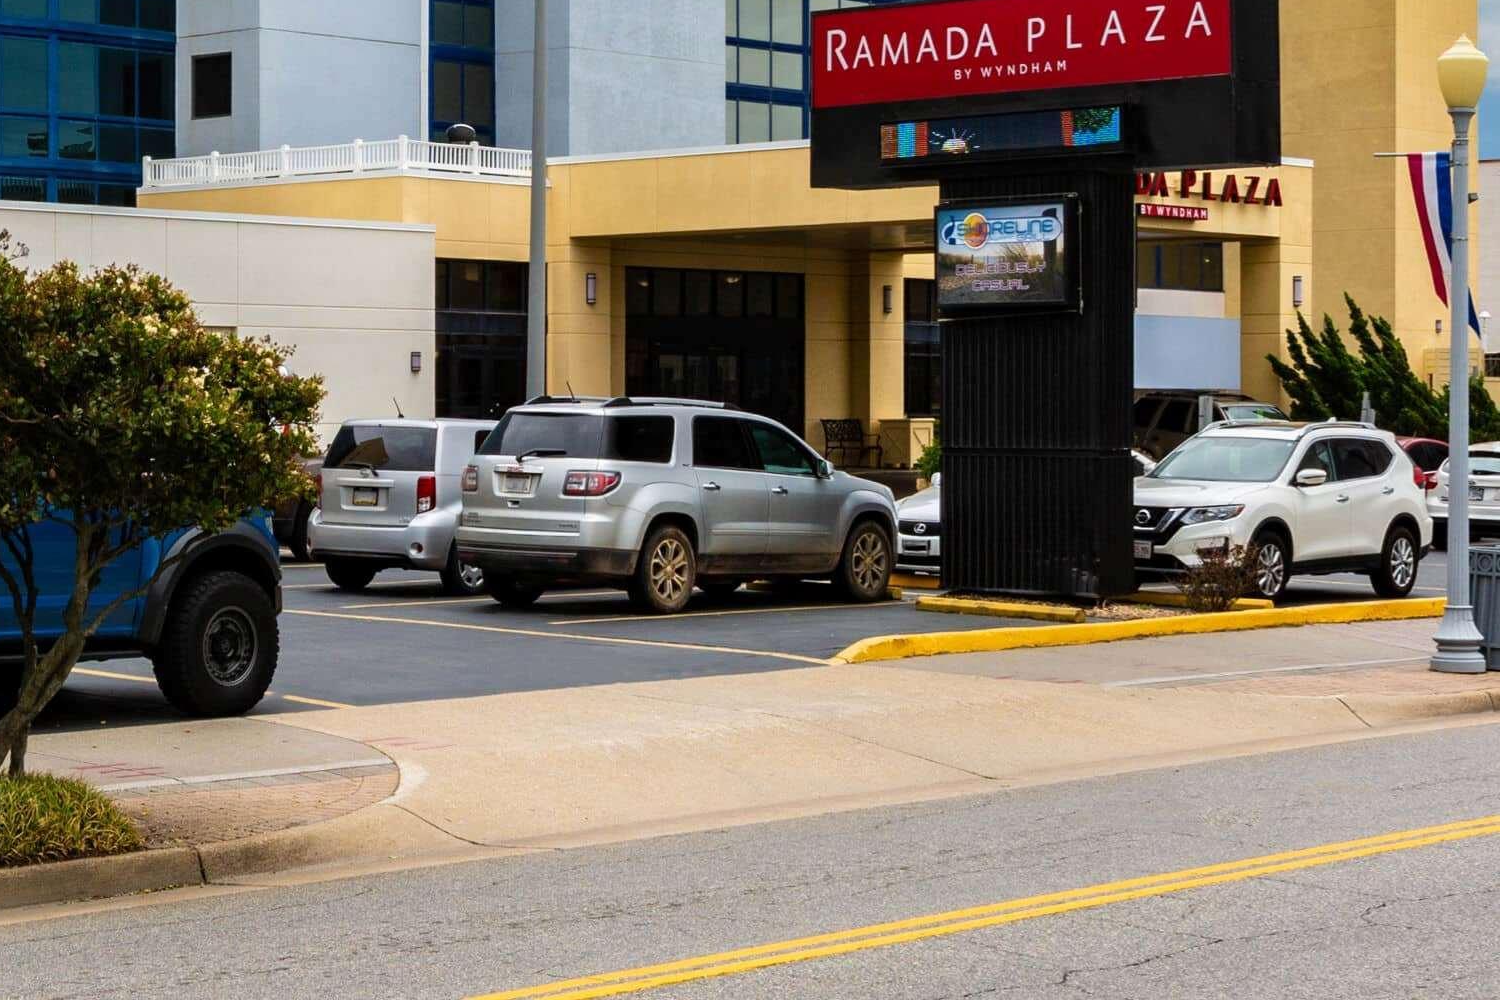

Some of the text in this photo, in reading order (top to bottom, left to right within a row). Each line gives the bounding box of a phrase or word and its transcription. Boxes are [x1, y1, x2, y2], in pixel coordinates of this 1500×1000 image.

[826, 1, 1212, 72] RAMADA PLAZA
[954, 60, 1067, 80] BY WYNDHAM
[1180, 169, 1283, 207] PLAZA
[1140, 204, 1208, 218] BY WYNDHAM
